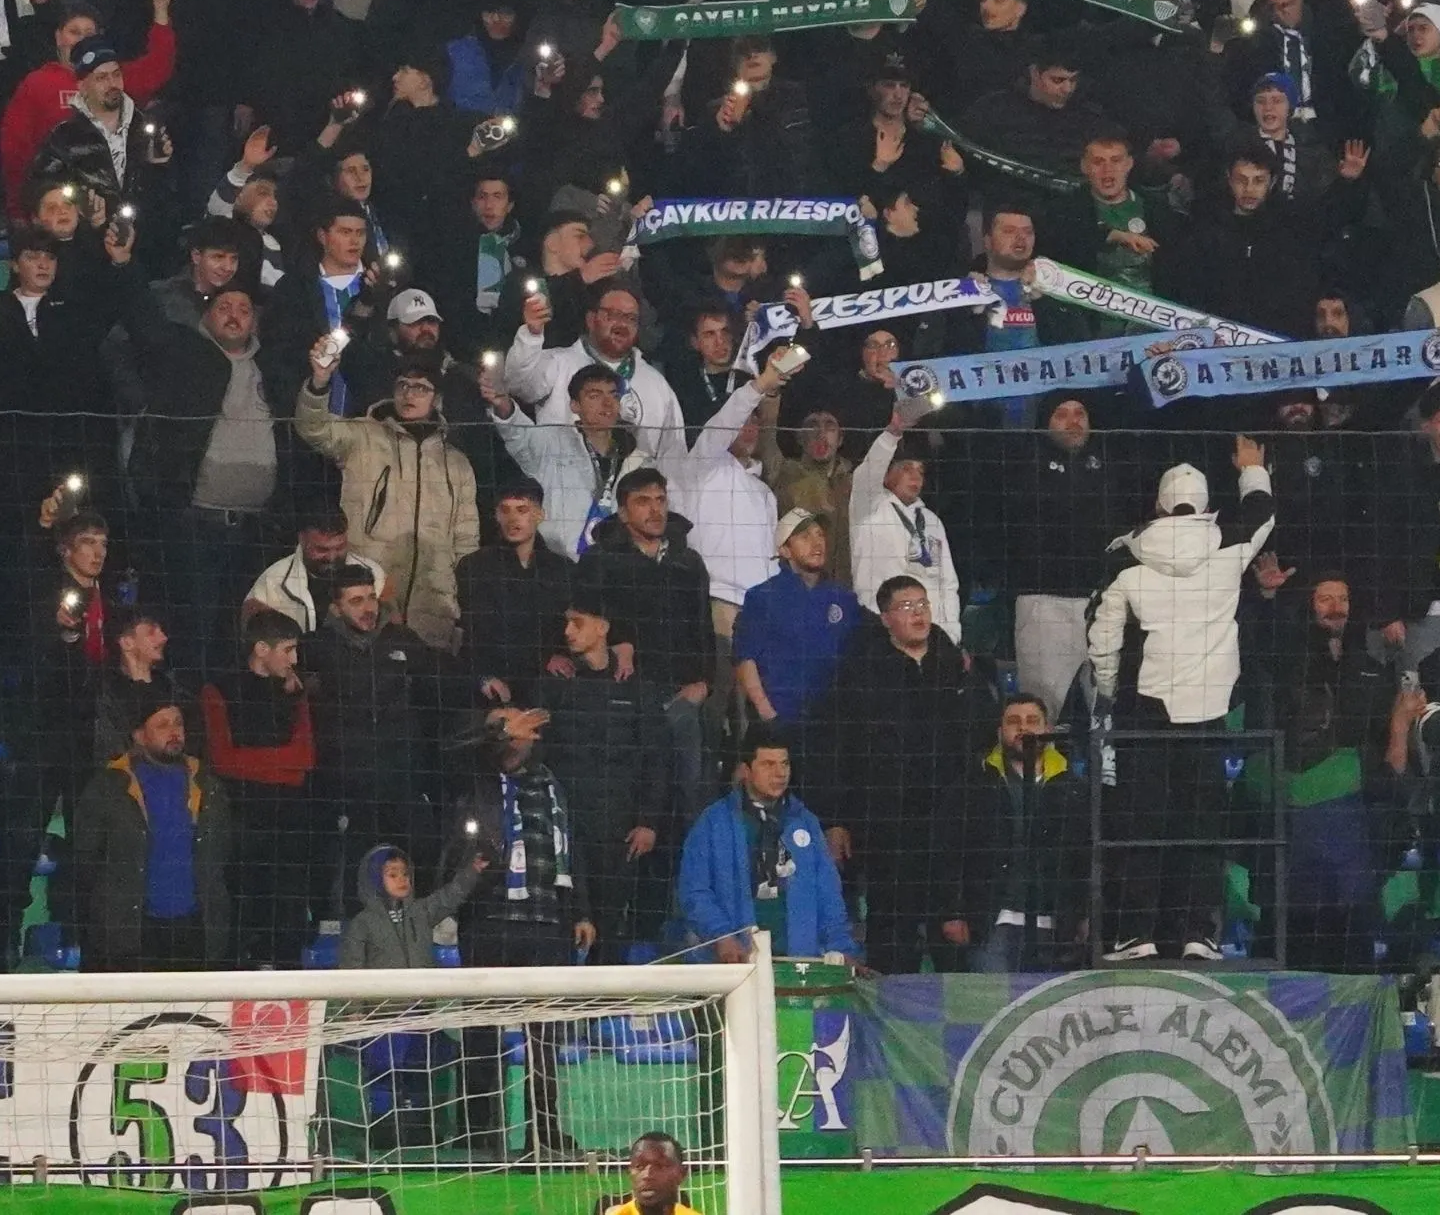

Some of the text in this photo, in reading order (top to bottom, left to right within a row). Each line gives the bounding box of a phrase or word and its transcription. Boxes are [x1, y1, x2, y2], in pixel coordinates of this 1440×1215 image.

[644, 196, 866, 234] ÇAYKUR RİZESPO
[765, 278, 963, 330] RZESPOR
[1066, 280, 1177, 328] CÜMLE
[948, 349, 1136, 391] ATİNALILA
[107, 1044, 249, 1190] 53
